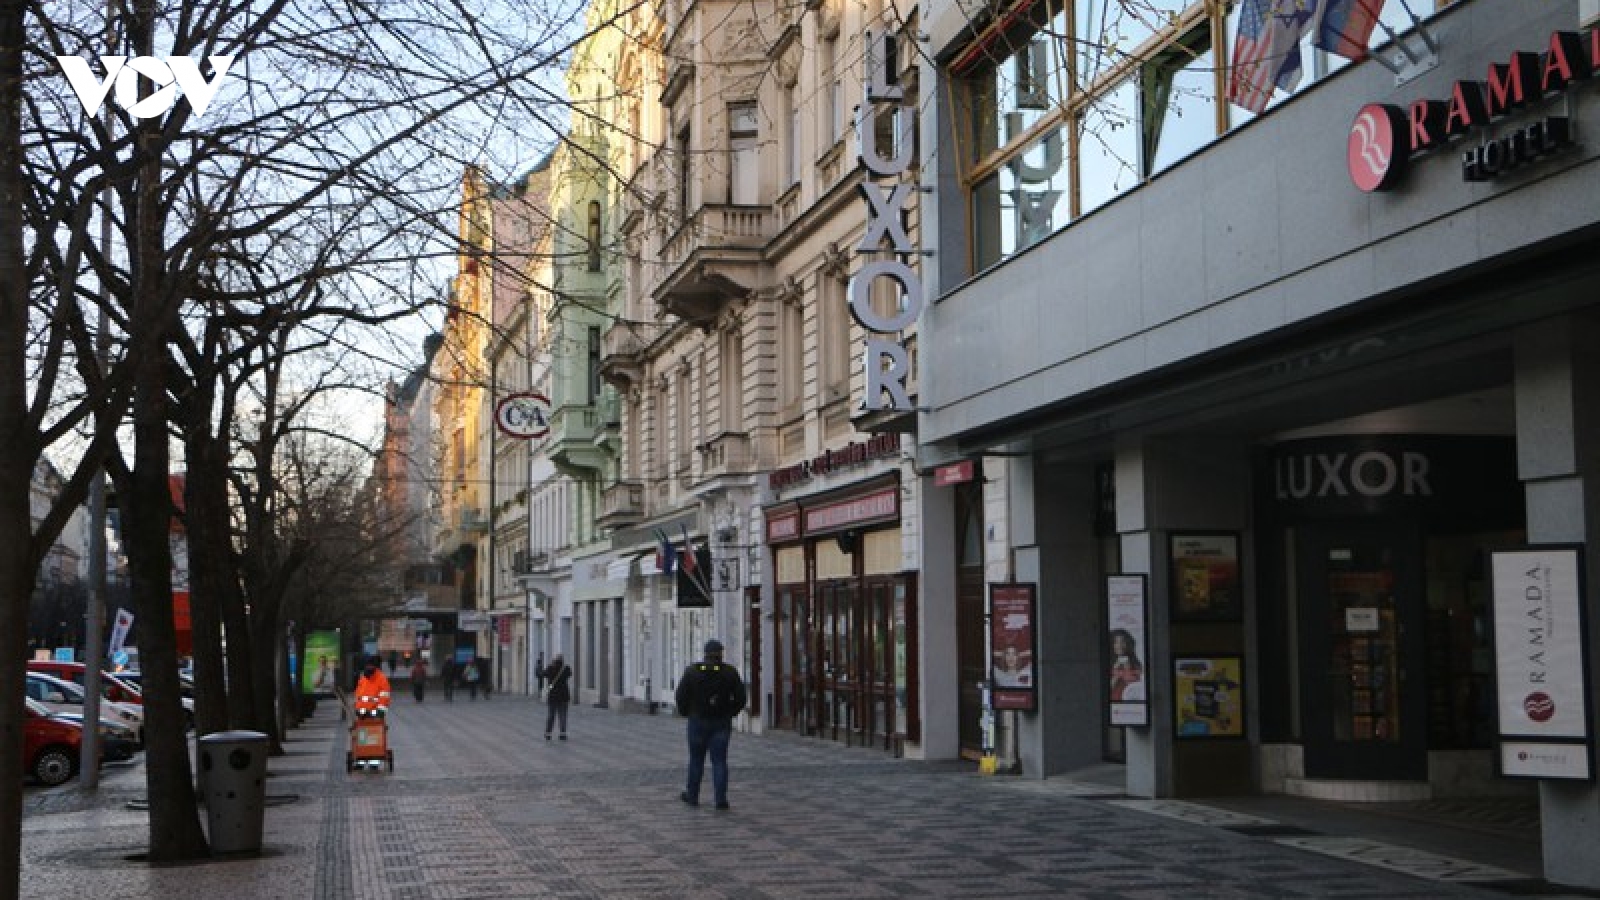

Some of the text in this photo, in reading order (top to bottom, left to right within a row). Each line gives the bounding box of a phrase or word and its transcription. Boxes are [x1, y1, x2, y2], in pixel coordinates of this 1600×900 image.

[1462, 117, 1558, 180] HOTEL
[847, 30, 922, 411] LUXOR
[1275, 452, 1432, 498] LUXOR
[1525, 564, 1546, 683] RAMADA
